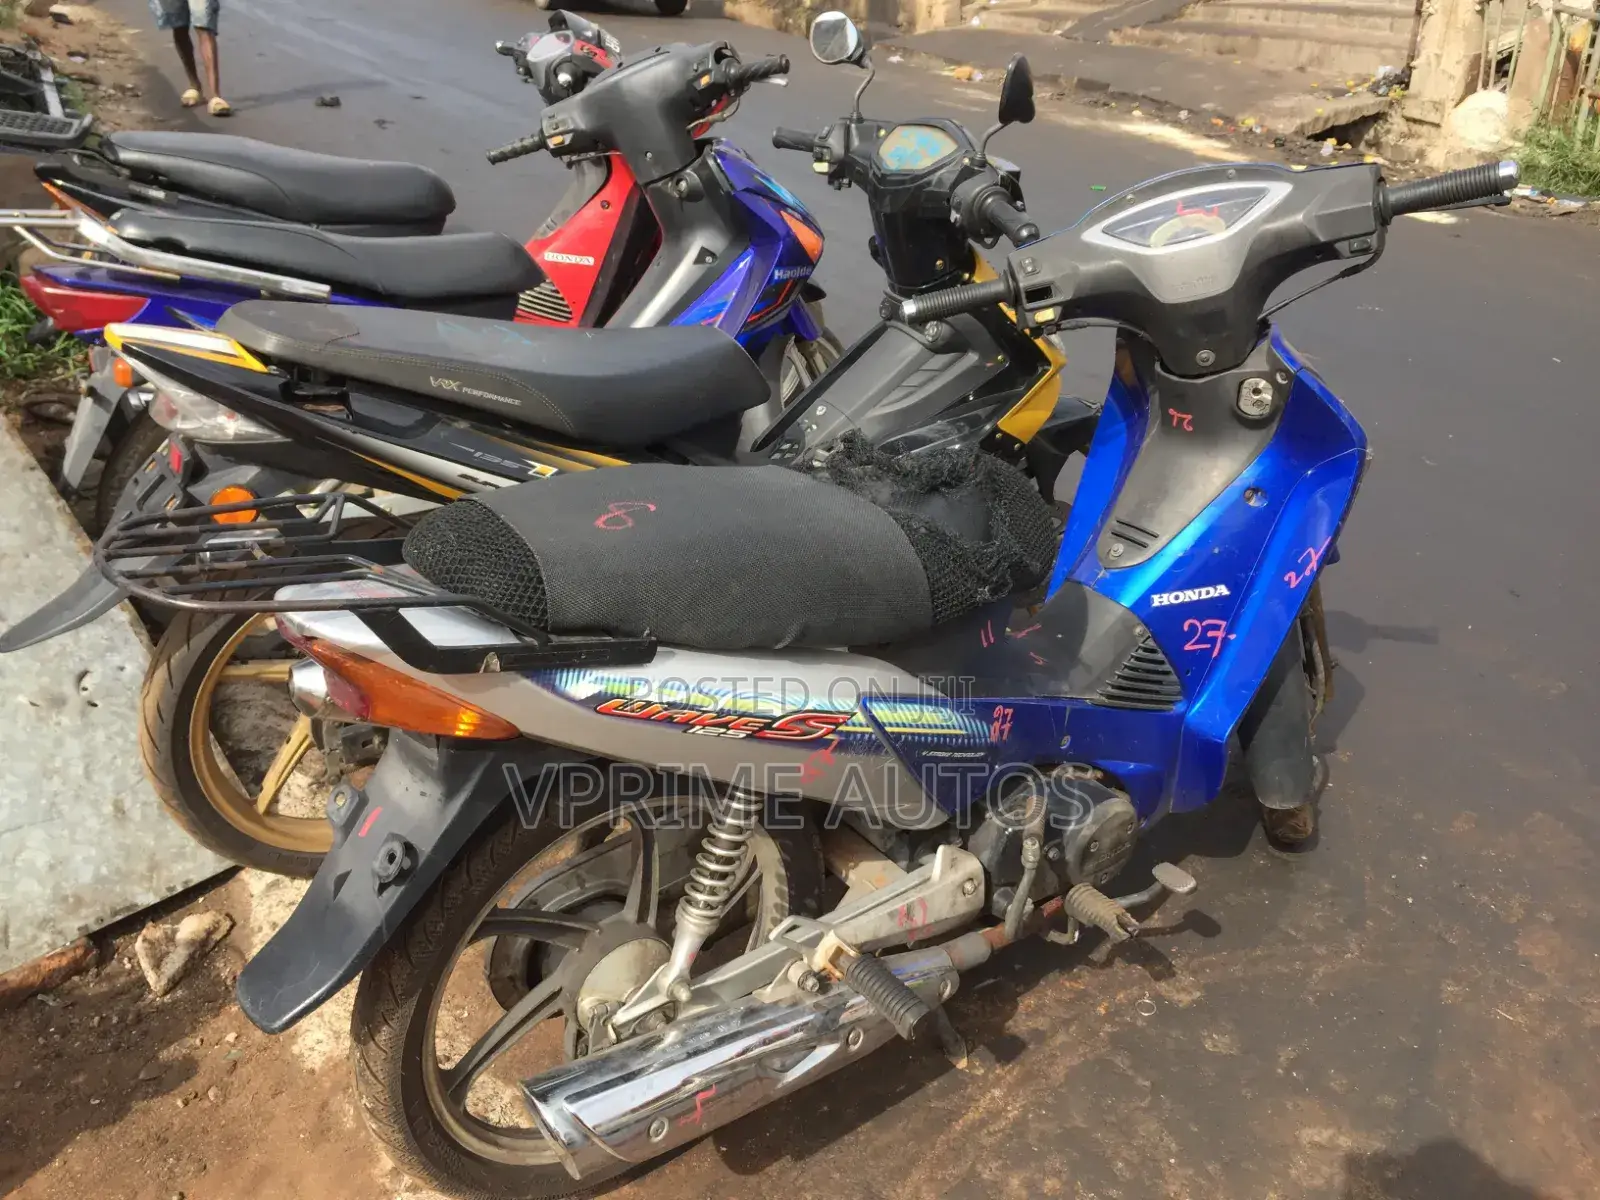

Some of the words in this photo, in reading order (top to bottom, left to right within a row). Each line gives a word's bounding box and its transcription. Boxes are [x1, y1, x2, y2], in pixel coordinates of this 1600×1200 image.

[462, 386, 522, 406] PERFORMANCE
[1151, 584, 1231, 607] HONDA
[686, 725, 752, 740] 125
